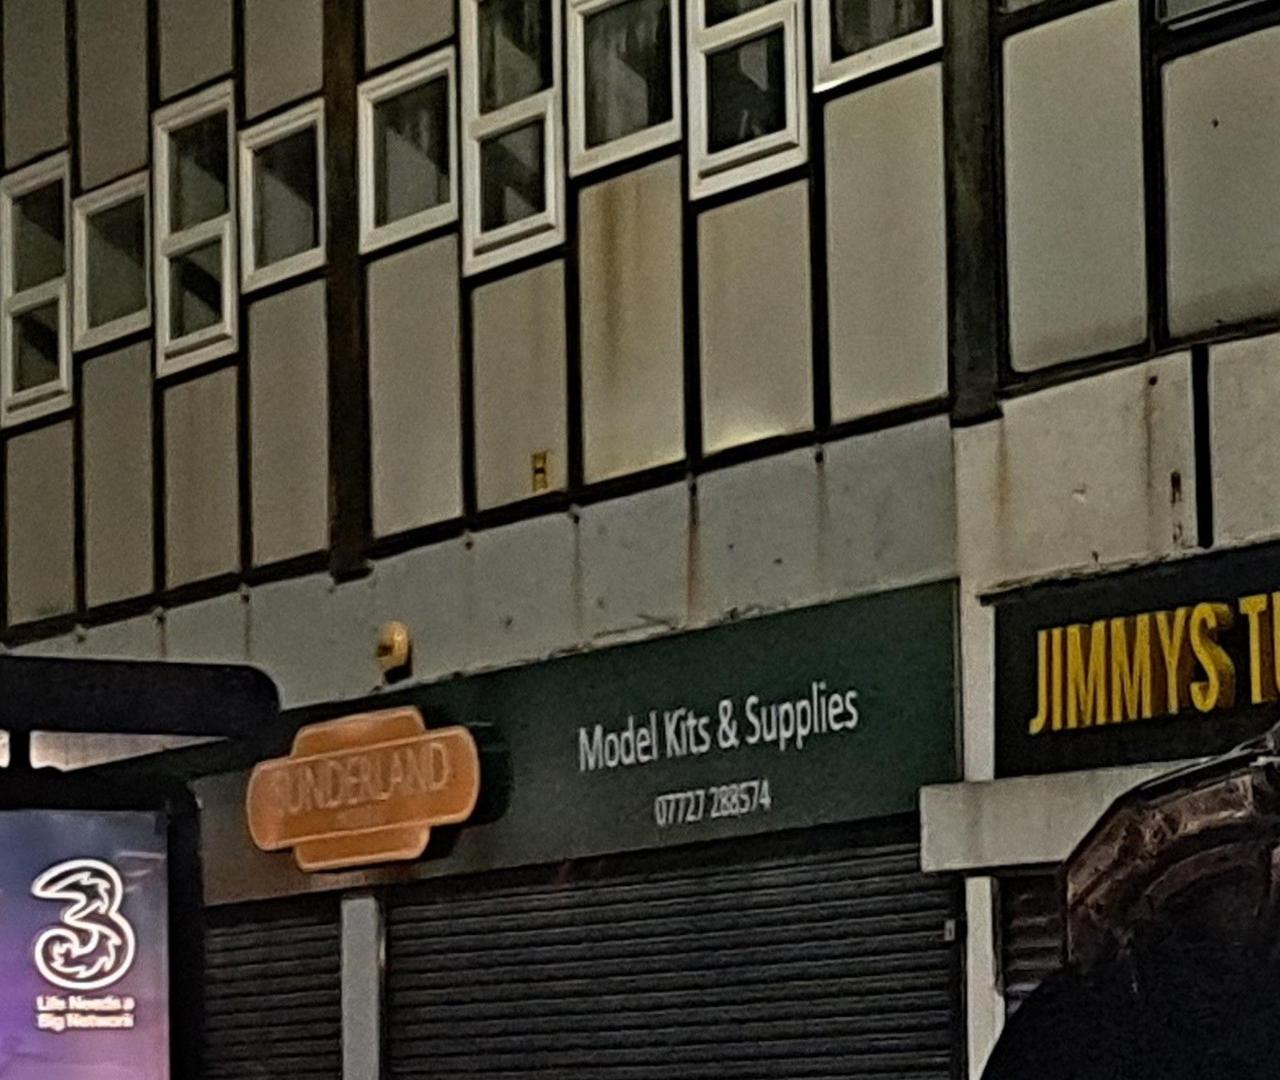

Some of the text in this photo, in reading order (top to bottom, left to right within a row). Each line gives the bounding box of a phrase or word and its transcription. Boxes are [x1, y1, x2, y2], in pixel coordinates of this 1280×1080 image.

[1028, 601, 1232, 736] JIMMYS
[578, 680, 859, 772] Model Kits & Supplies
[654, 788, 706, 827] 07727
[31, 858, 137, 990] 3
